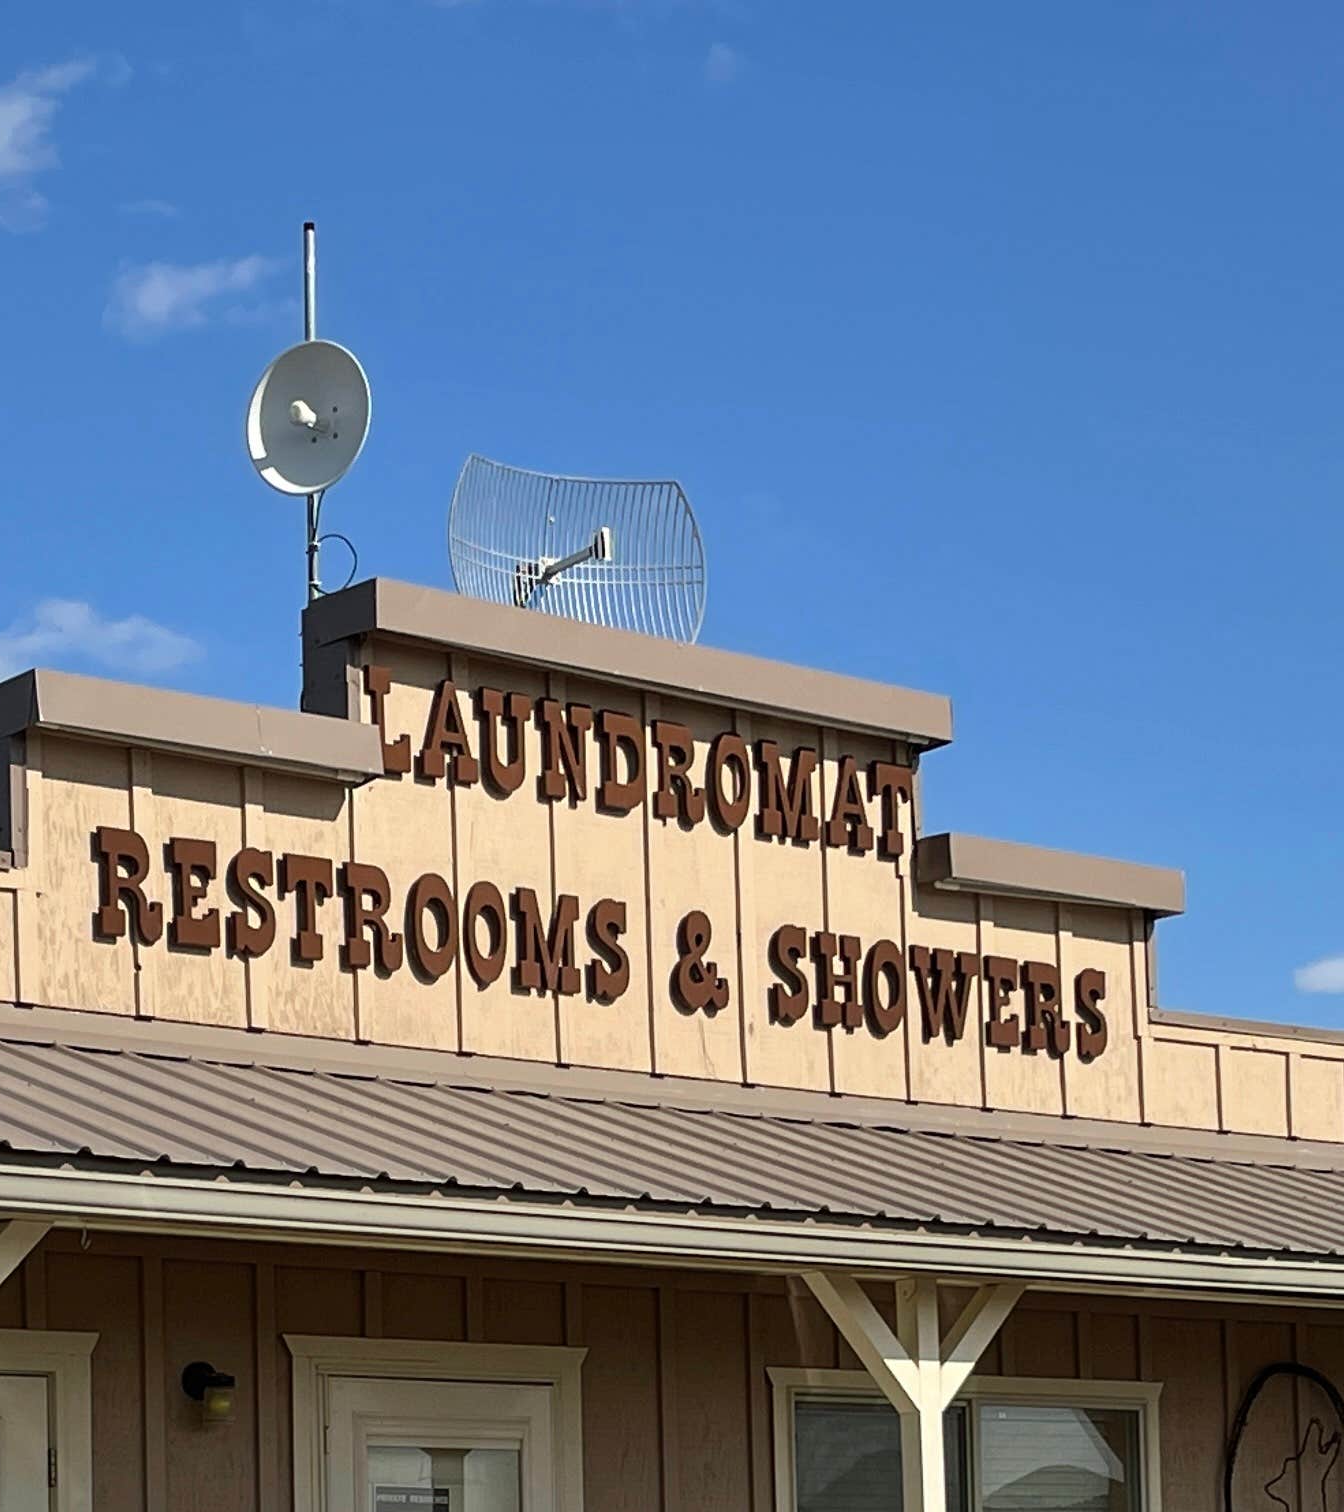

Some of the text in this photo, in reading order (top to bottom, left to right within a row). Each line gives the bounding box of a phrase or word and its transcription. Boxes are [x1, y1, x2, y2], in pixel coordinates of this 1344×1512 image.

[364, 665, 914, 860] LAUNDROMAT
[90, 826, 1109, 1061] RESTROOMS & SHOWERS
